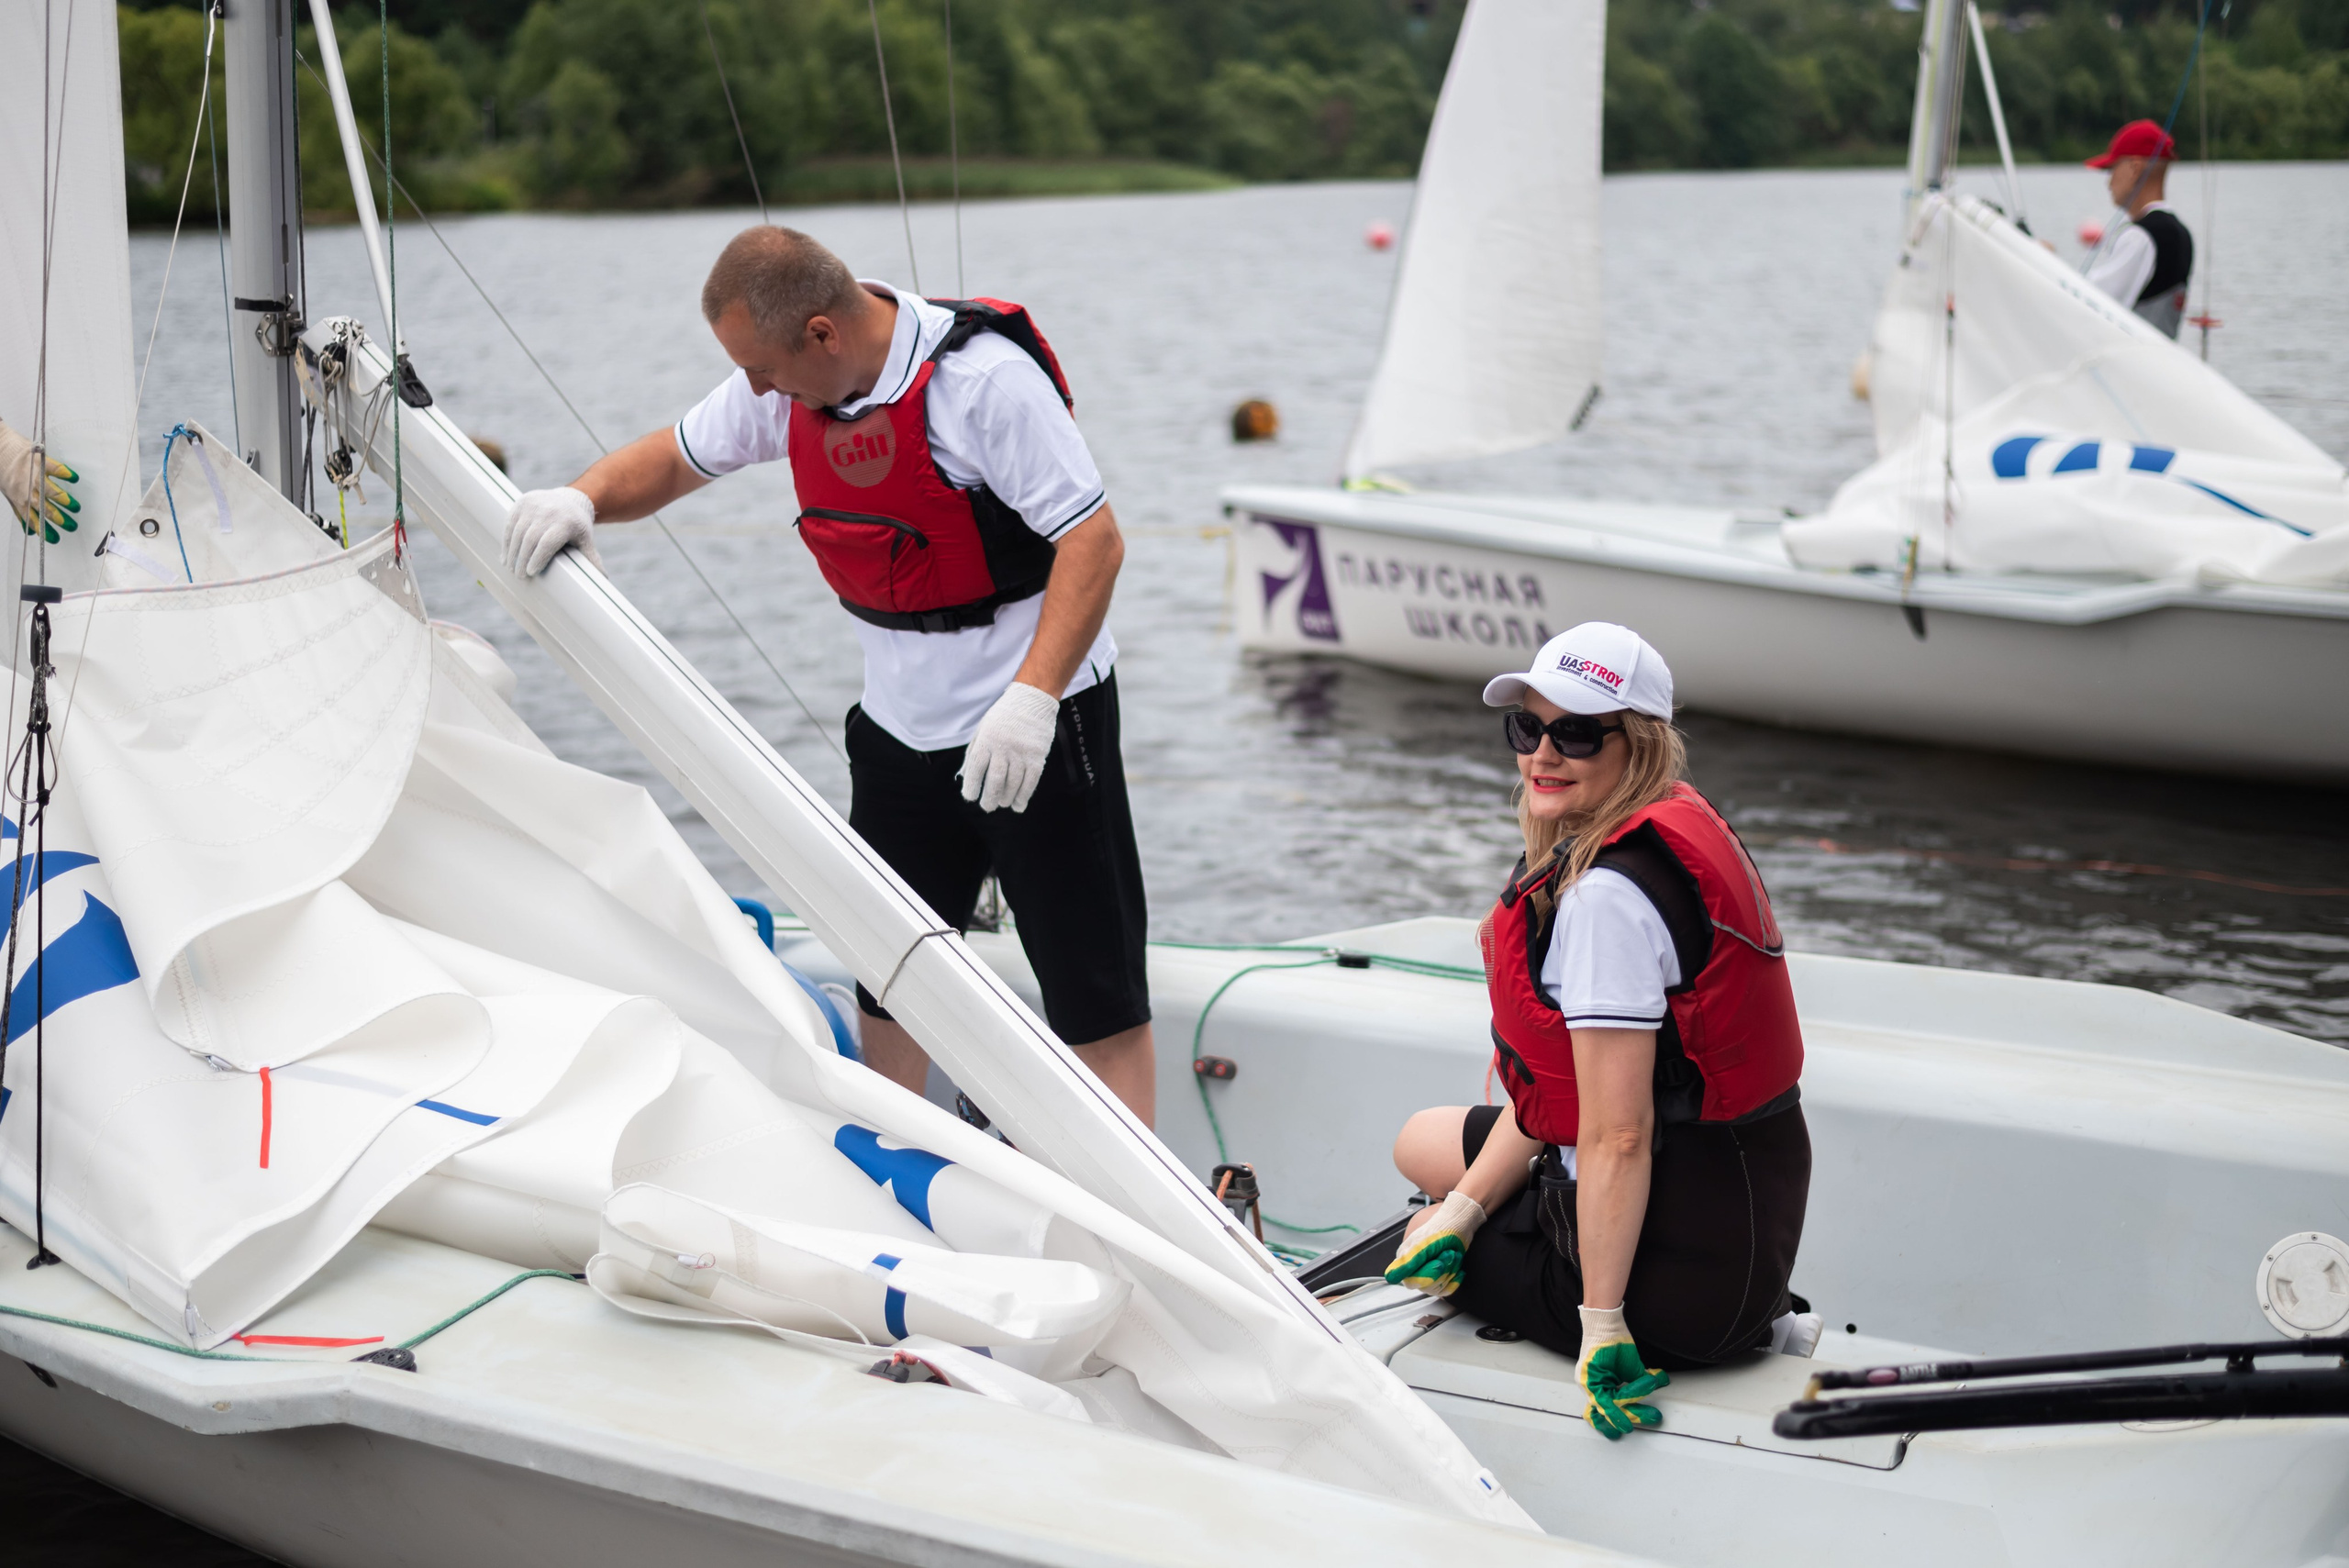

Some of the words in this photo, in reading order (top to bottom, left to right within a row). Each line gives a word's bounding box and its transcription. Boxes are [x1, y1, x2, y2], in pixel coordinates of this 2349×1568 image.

[831, 433, 889, 467] Gill
[1337, 552, 1548, 609] ПАРУСНАЯ
[1589, 677, 1618, 695] construction
[1078, 736, 1096, 787] CASUAL
